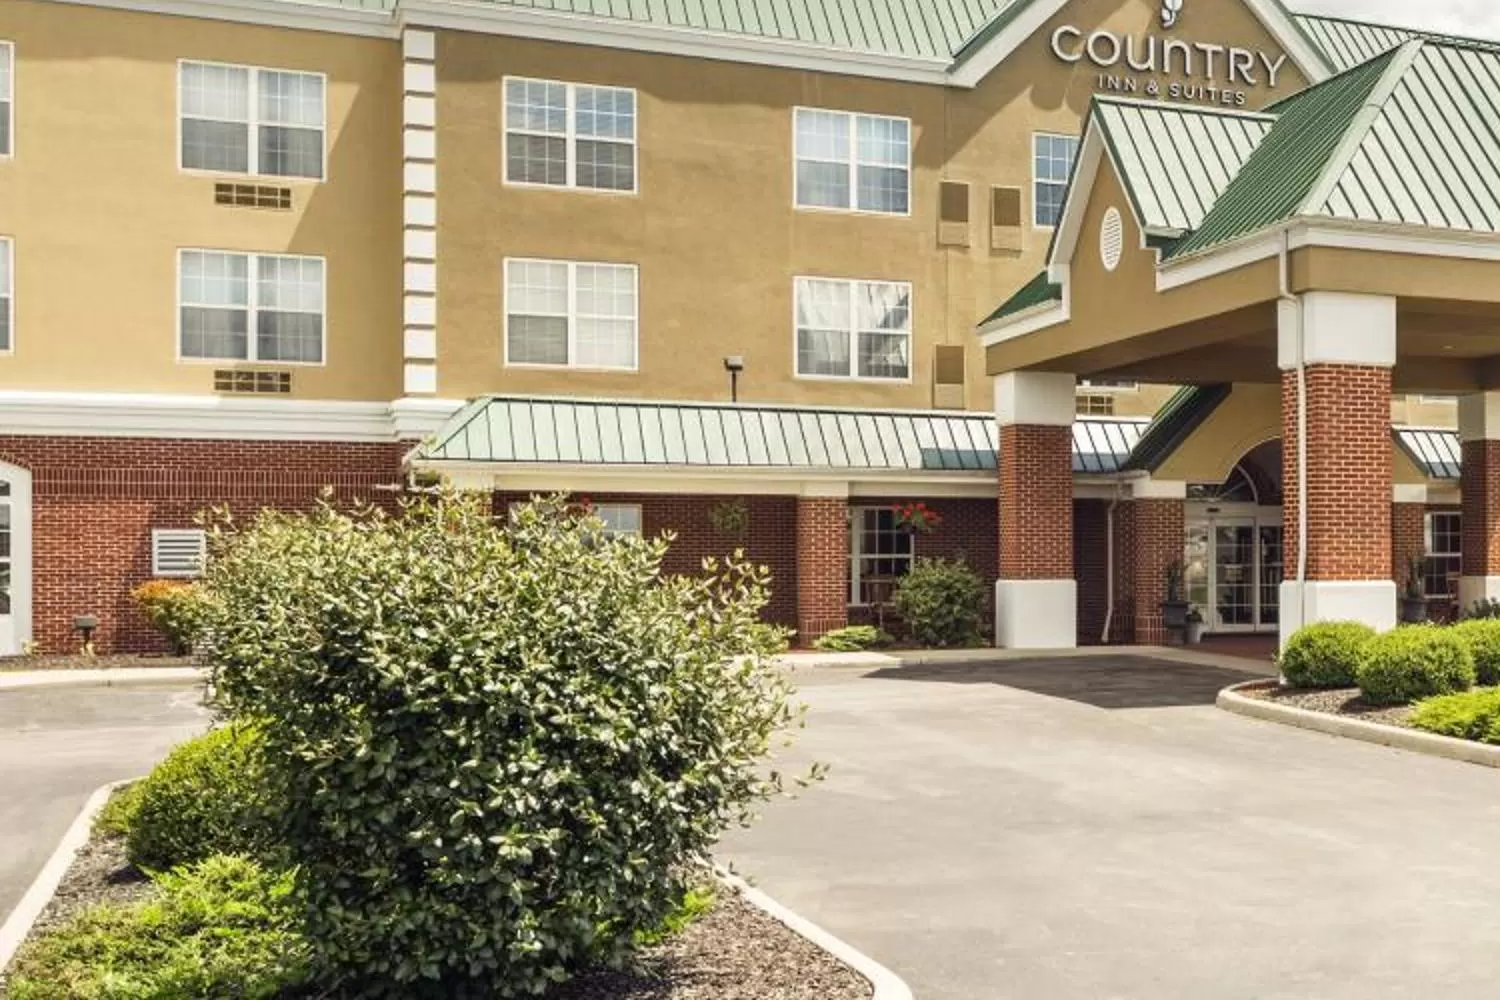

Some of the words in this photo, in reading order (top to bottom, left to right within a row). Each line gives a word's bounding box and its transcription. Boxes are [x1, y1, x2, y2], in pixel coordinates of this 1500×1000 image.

[1098, 74, 1137, 92] INN
[1145, 79, 1160, 96] &
[1168, 82, 1247, 106] SUITES
